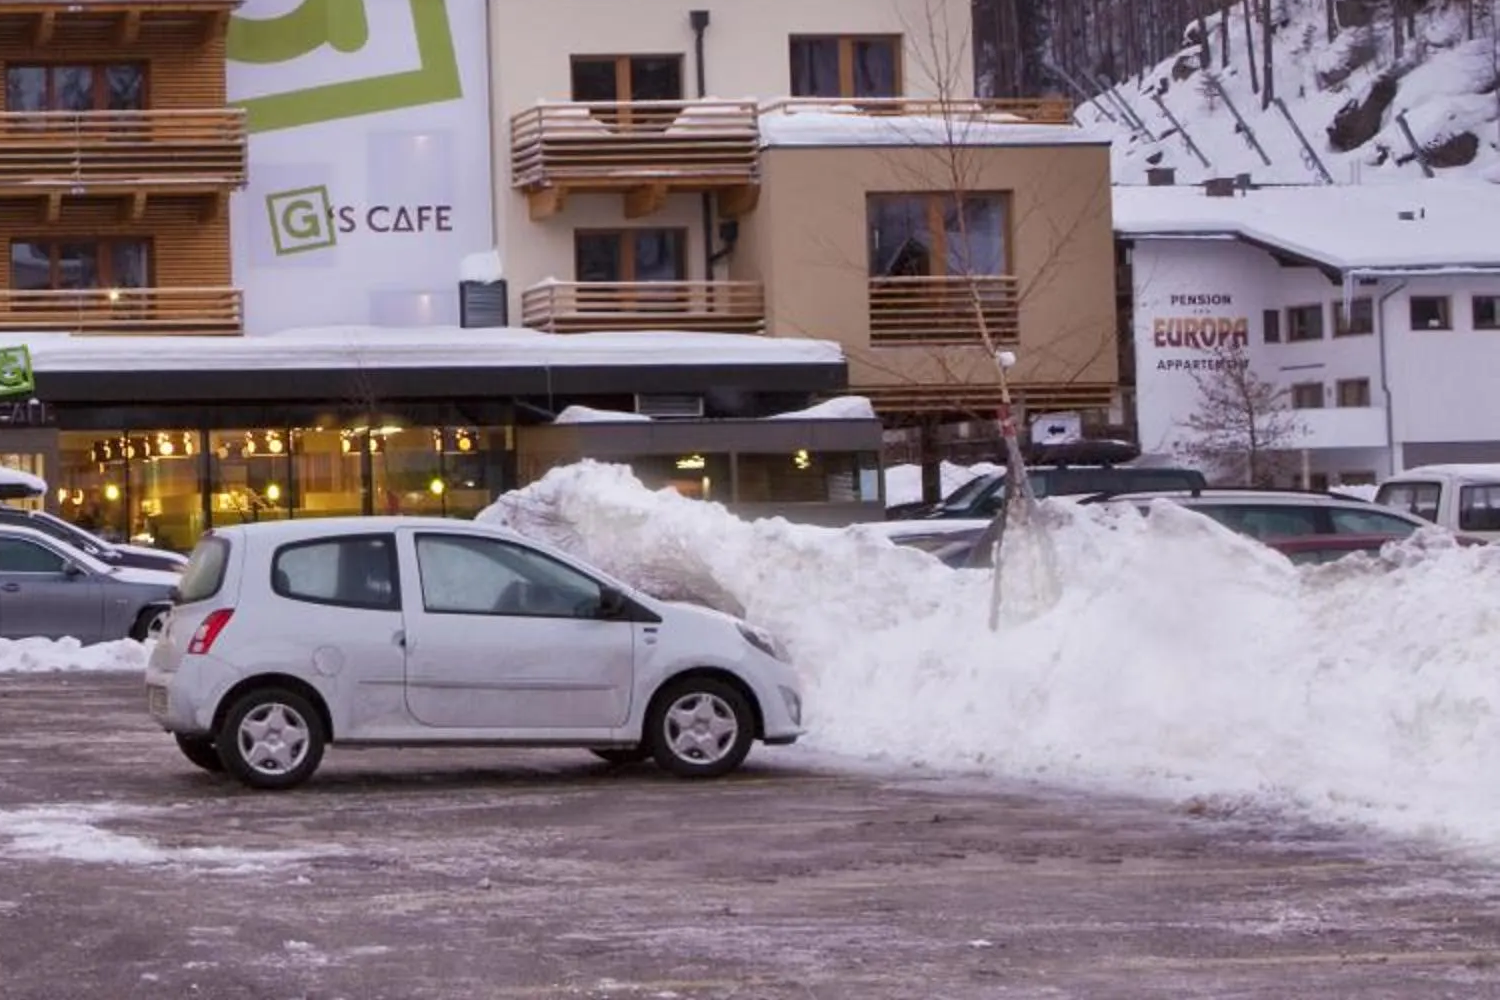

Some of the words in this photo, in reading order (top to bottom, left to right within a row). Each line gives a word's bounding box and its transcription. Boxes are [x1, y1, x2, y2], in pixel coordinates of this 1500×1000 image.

[366, 205, 453, 233] CAFE
[1170, 294, 1232, 306] PENSION
[1154, 317, 1249, 349] EUROPA
